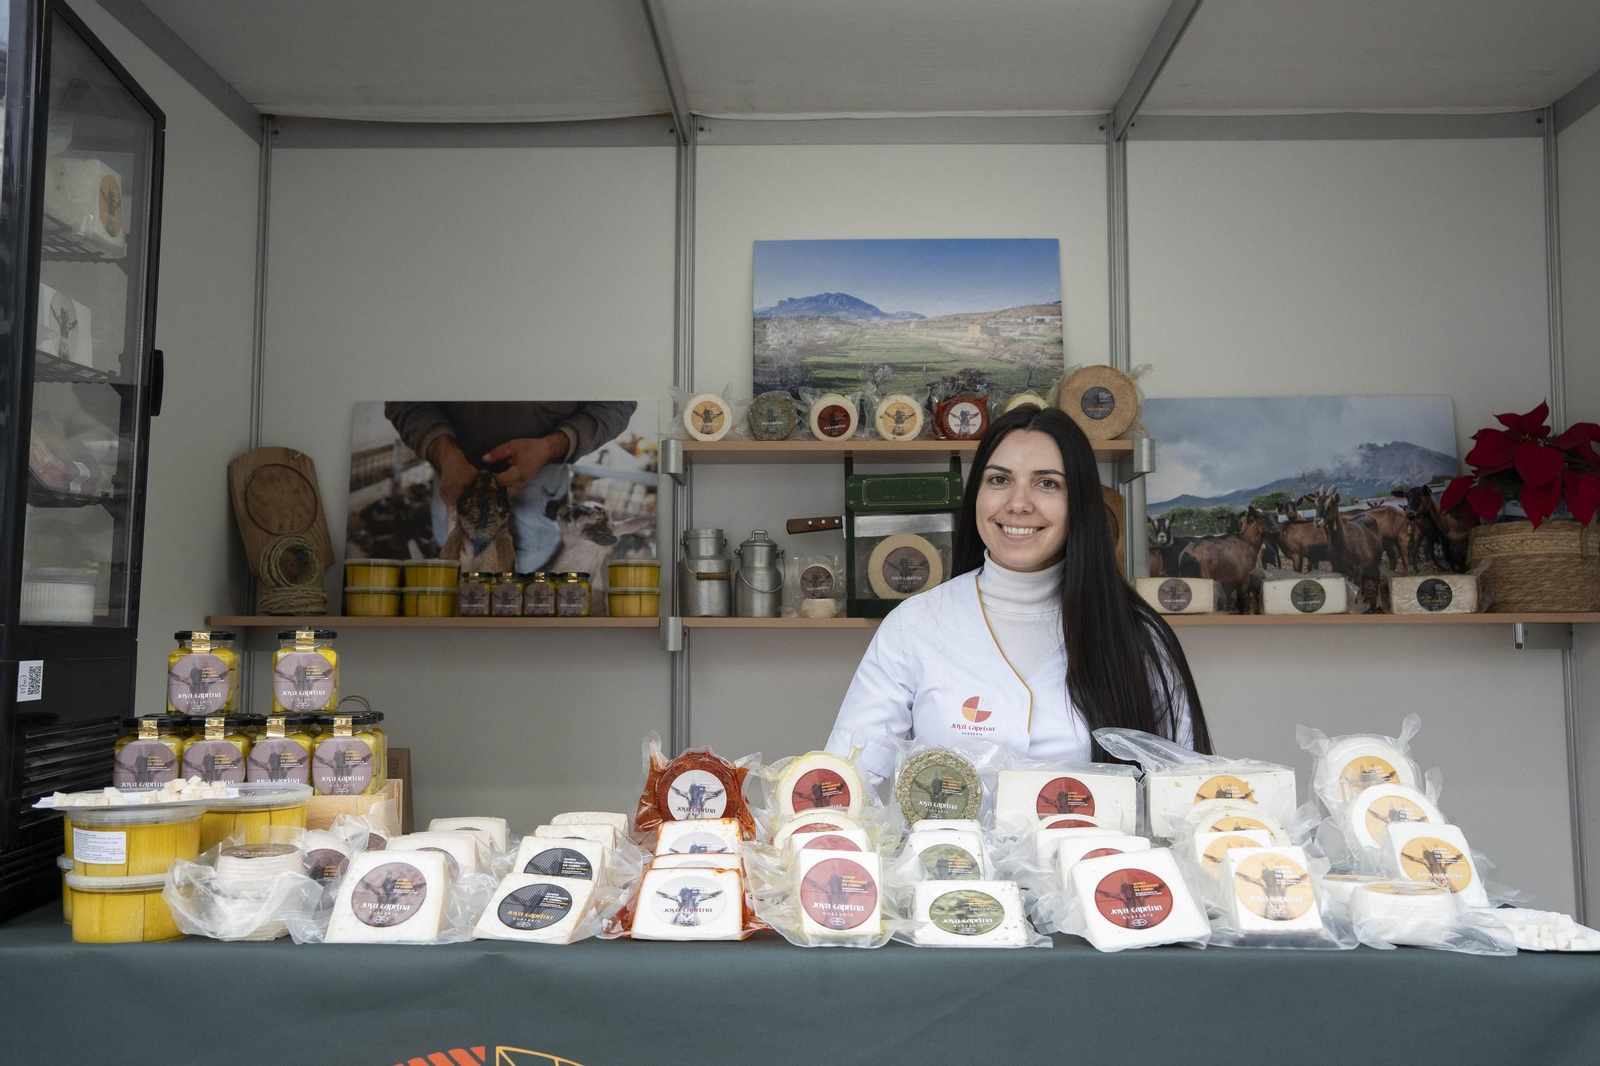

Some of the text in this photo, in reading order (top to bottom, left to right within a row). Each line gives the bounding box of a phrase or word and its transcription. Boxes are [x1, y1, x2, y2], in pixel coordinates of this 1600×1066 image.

[380, 903, 410, 911] caprina
[812, 902, 864, 911] Joya caprina
[1110, 905, 1163, 915] Joya caprina
[525, 911, 554, 920] caprina
